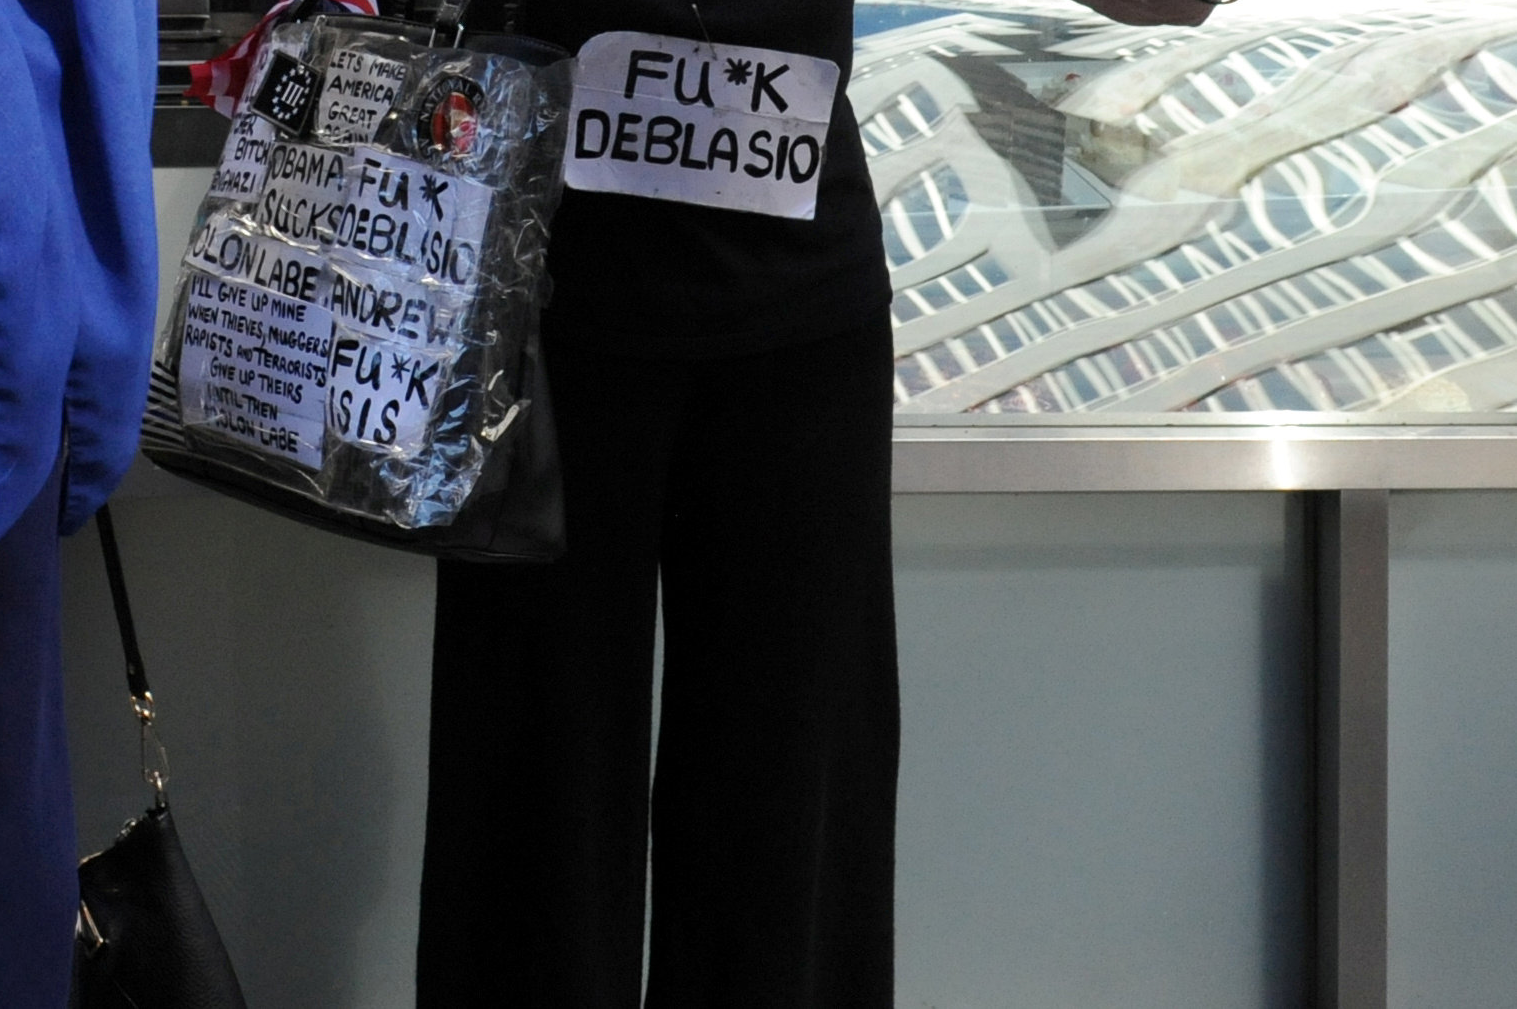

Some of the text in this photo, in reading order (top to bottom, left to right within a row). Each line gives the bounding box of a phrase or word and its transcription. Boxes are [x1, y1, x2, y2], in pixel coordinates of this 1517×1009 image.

[326, 74, 395, 106] AMERICA
[368, 59, 408, 82] MAKE
[327, 100, 378, 130] GREAT
[574, 107, 821, 184] DEBLASIO
[270, 144, 344, 193] OBAMA
[260, 188, 344, 246] SUCKS
[191, 221, 321, 303] OLON LABE
[217, 281, 248, 308] GIVE
[251, 292, 269, 312] UP
[270, 298, 307, 323] MINE
[187, 302, 220, 326] WHEN
[268, 325, 329, 359] MUGGERS
[184, 324, 234, 359] RAPISTS
[253, 346, 328, 389] TERRORISTS
[238, 368, 256, 387] UP
[257, 373, 304, 405] THEIRS
[242, 393, 278, 422] THEN
[258, 421, 300, 454] LABE
[330, 385, 400, 446] ISIS
